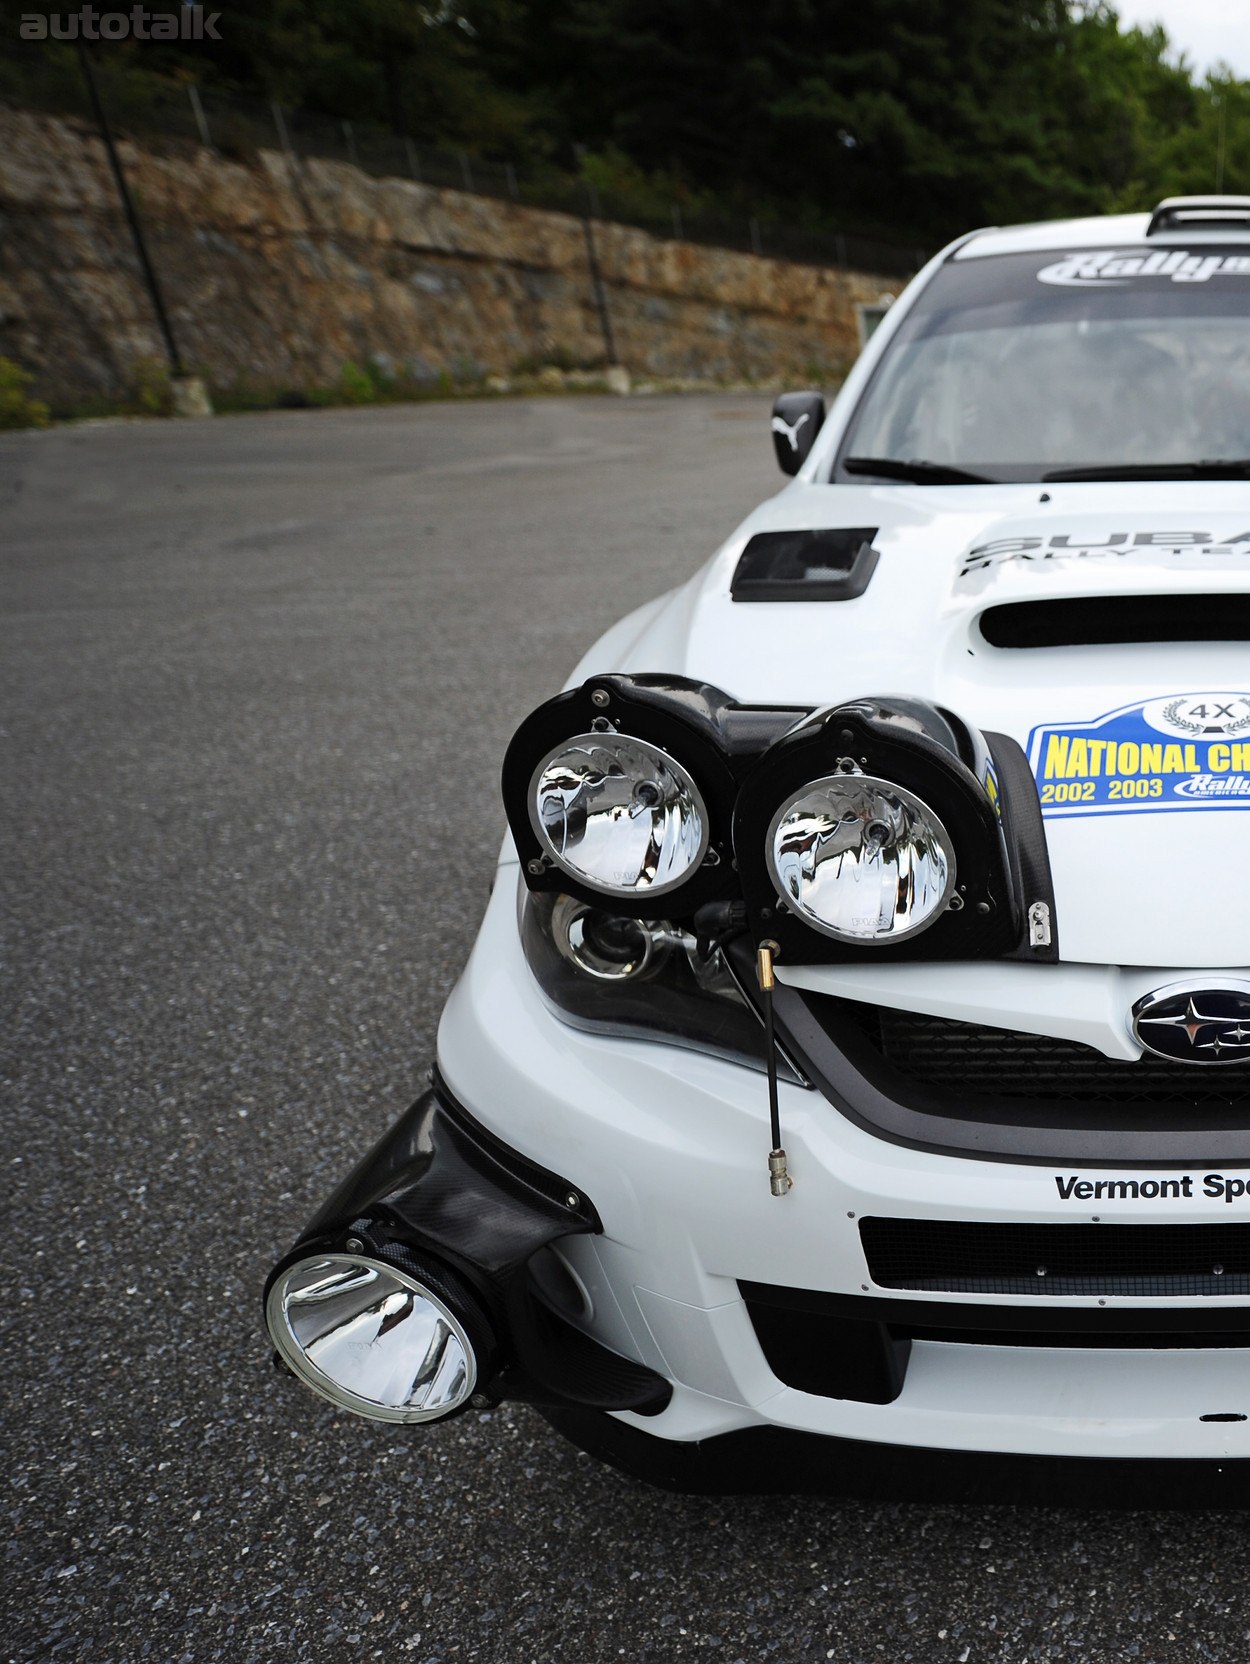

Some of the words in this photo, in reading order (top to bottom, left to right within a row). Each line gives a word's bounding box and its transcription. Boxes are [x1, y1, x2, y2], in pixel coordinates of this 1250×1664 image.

[1036, 250, 1222, 287] Rally
[1188, 703, 1237, 719] 4X
[1044, 734, 1200, 779] NATIONAL
[1041, 782, 1095, 803] 2002
[1107, 778, 1163, 800] 2003
[1054, 1175, 1194, 1200] Vermont
